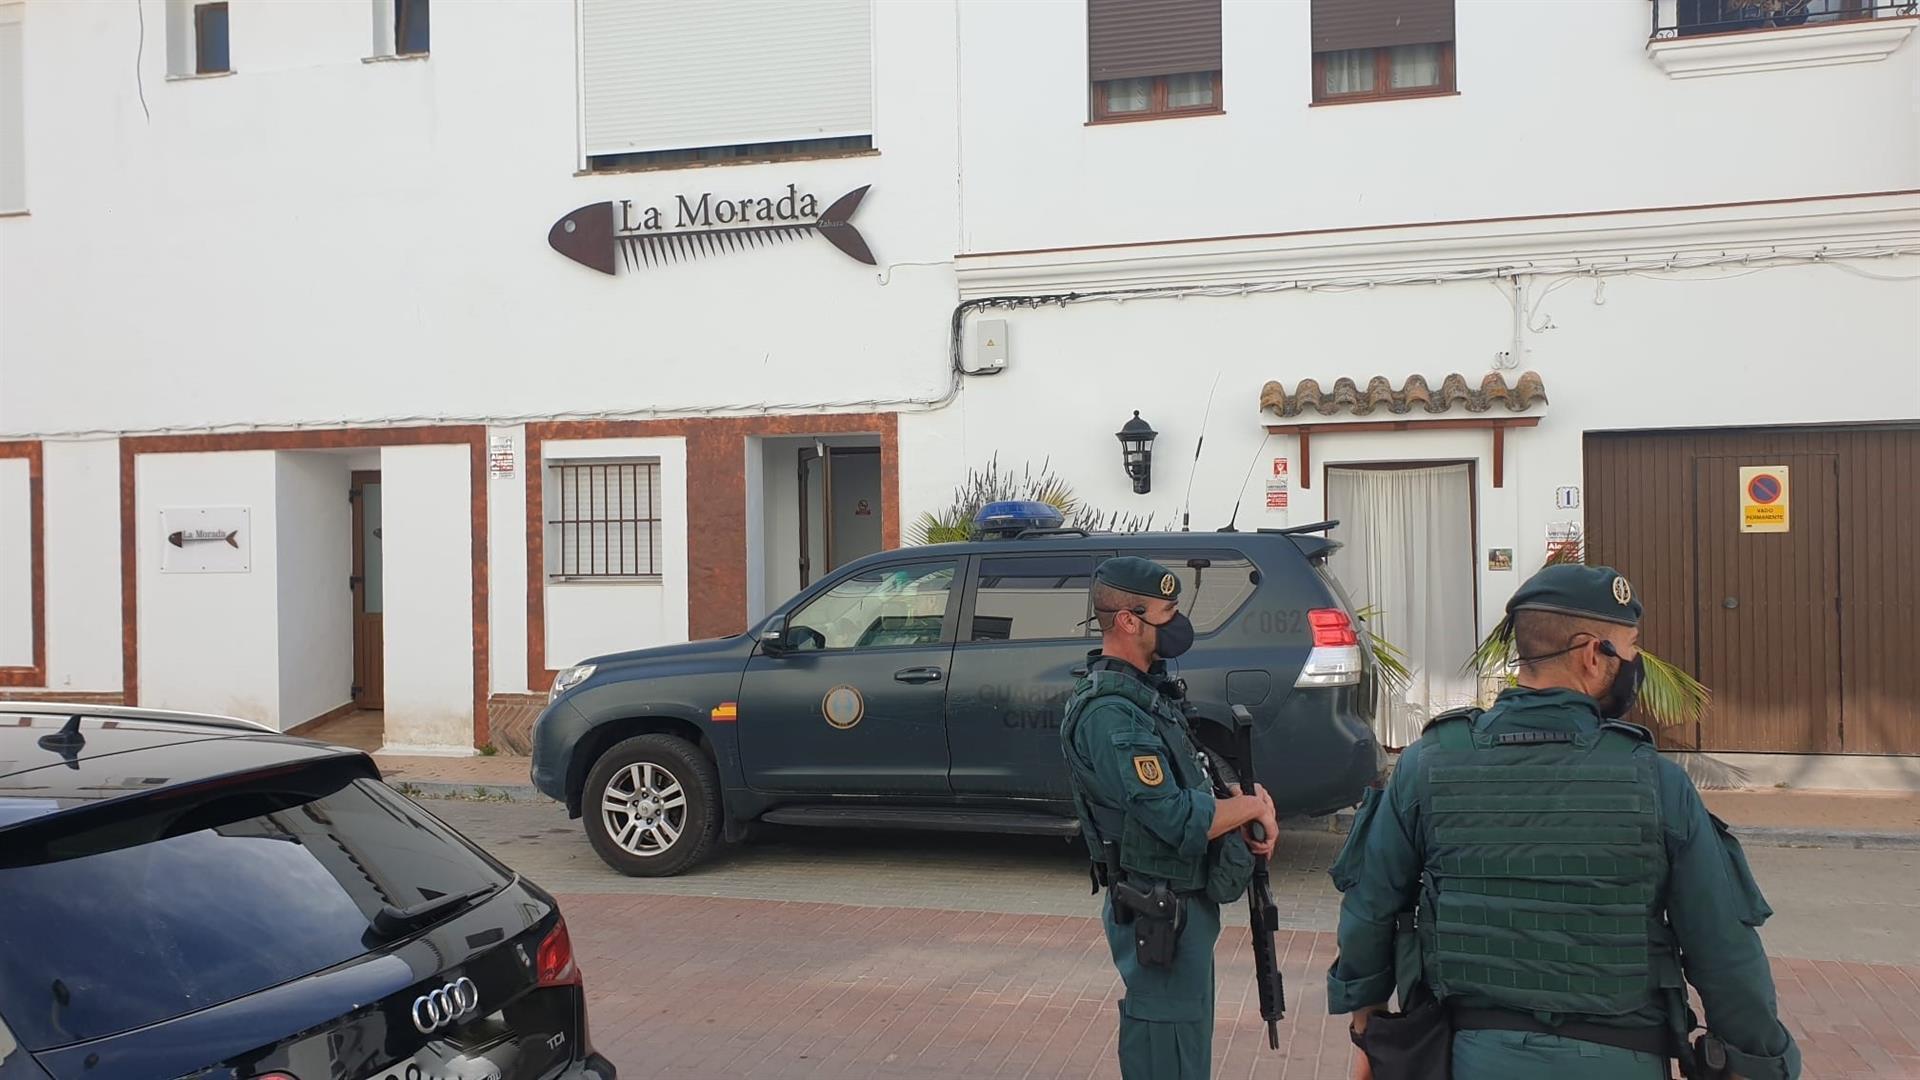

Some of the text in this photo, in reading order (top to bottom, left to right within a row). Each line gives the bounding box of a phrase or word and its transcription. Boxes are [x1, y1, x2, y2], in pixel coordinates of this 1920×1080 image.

[618, 183, 819, 232] La Morada
[1566, 489, 1571, 505] 1
[183, 529, 226, 538] La Morada
[1260, 609, 1301, 634] 062
[1003, 709, 1058, 729] CIVIL
[546, 1031, 565, 1050] TDI
